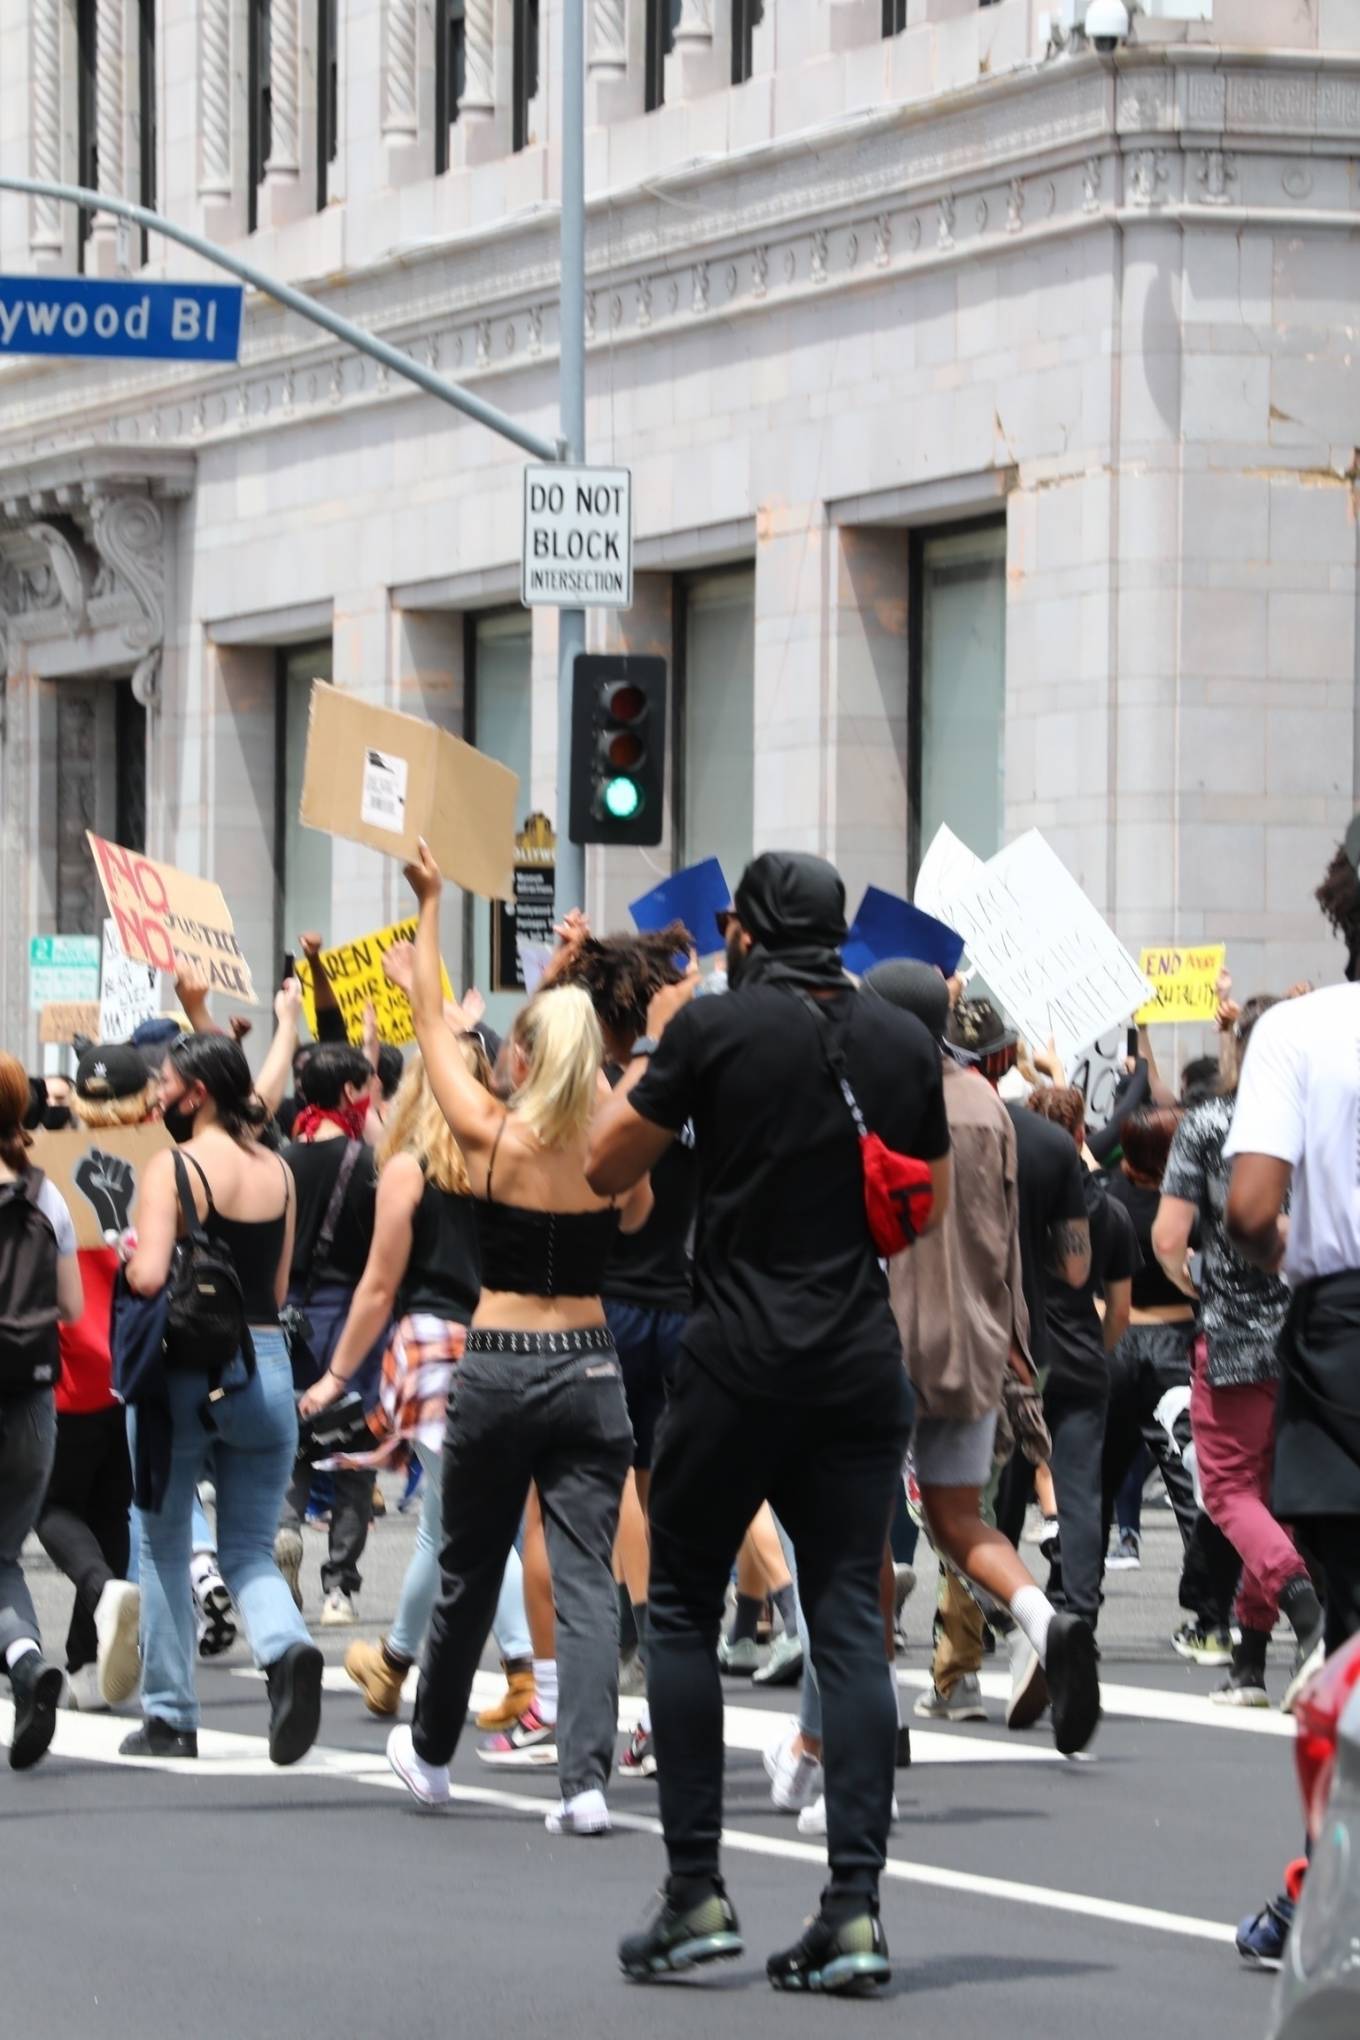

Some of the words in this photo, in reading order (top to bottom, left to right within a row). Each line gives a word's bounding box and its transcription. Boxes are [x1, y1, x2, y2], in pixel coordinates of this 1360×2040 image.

[171, 297, 217, 342] Bl
[531, 483, 564, 515] DO
[576, 484, 624, 517] NOT
[533, 527, 620, 562] BLOCK
[530, 568, 622, 593] INTERSECTION
[94, 835, 170, 914] NO
[112, 903, 176, 977] NO
[1146, 952, 1182, 977] END
